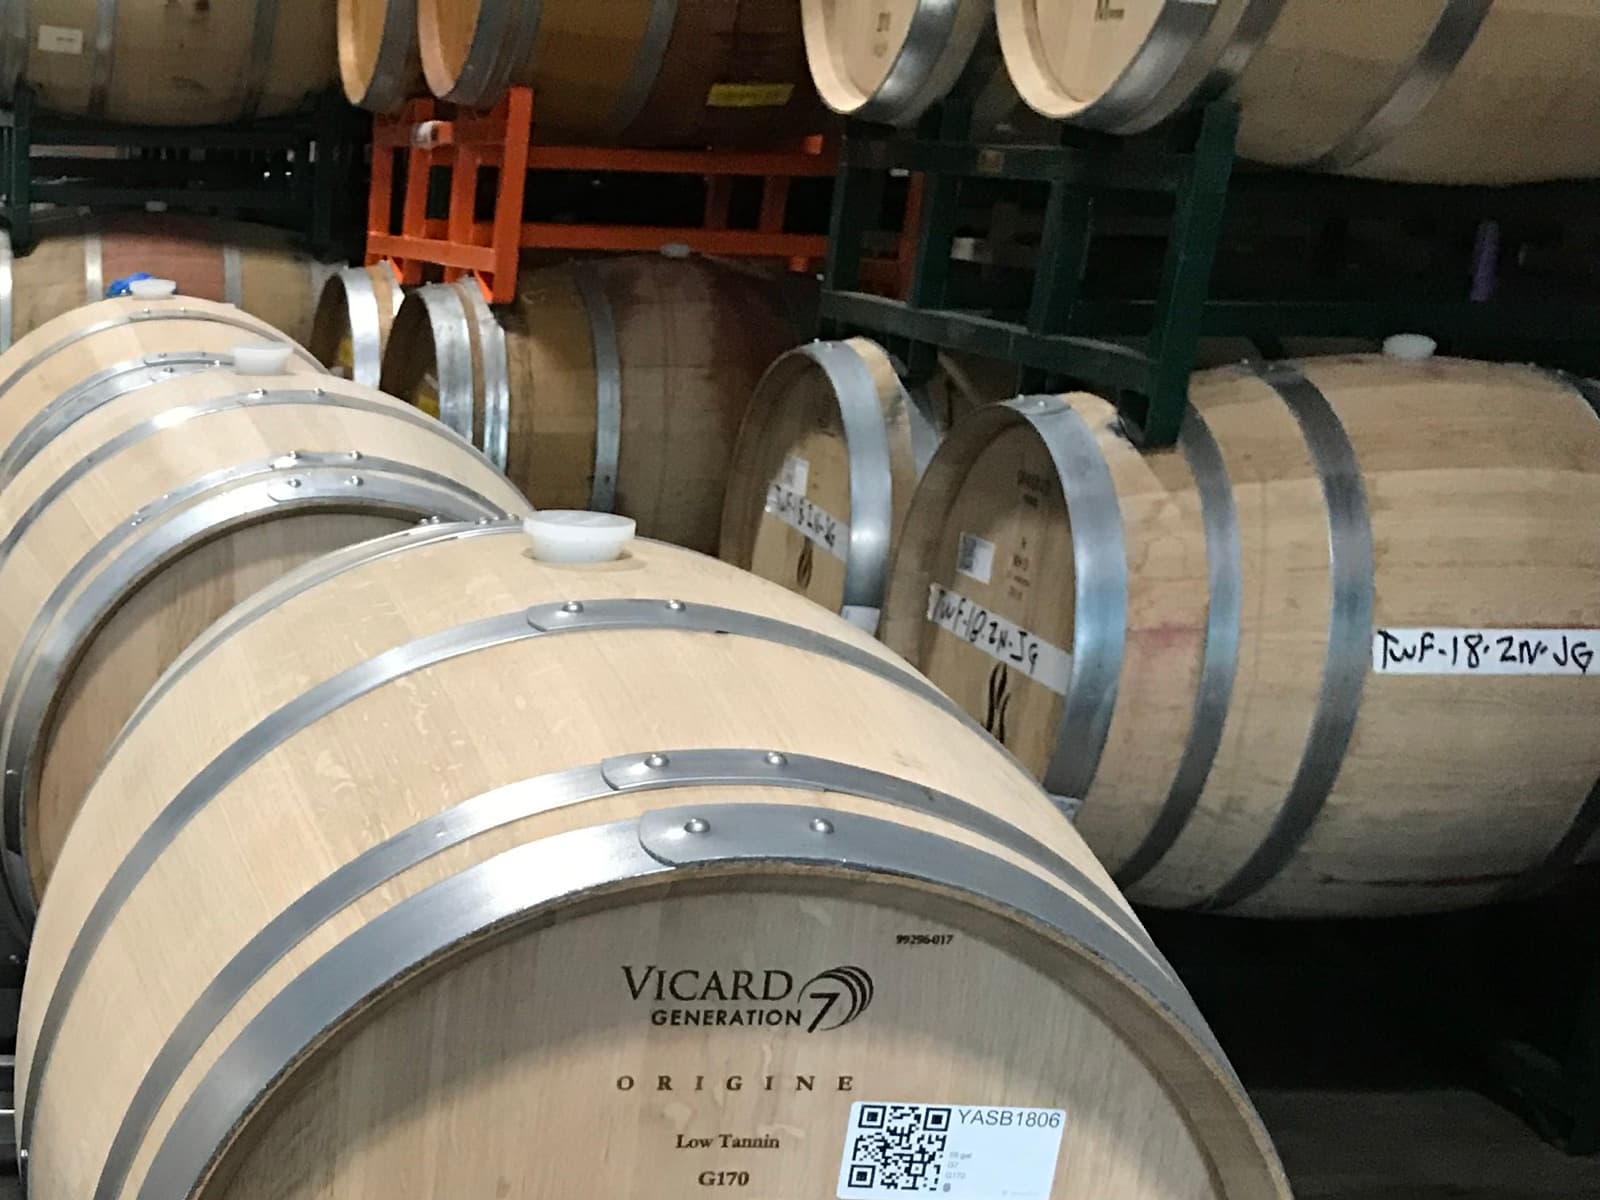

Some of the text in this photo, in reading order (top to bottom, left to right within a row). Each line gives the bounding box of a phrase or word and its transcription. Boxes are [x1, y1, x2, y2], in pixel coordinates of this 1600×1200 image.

[621, 965, 794, 1001] VICARD
[651, 1008, 802, 1027] GENERATION
[615, 1074, 854, 1092] ORIGINE
[957, 1108, 1062, 1129] YASB1806
[675, 1133, 781, 1149] Low Tannin
[697, 1170, 750, 1187] G170
